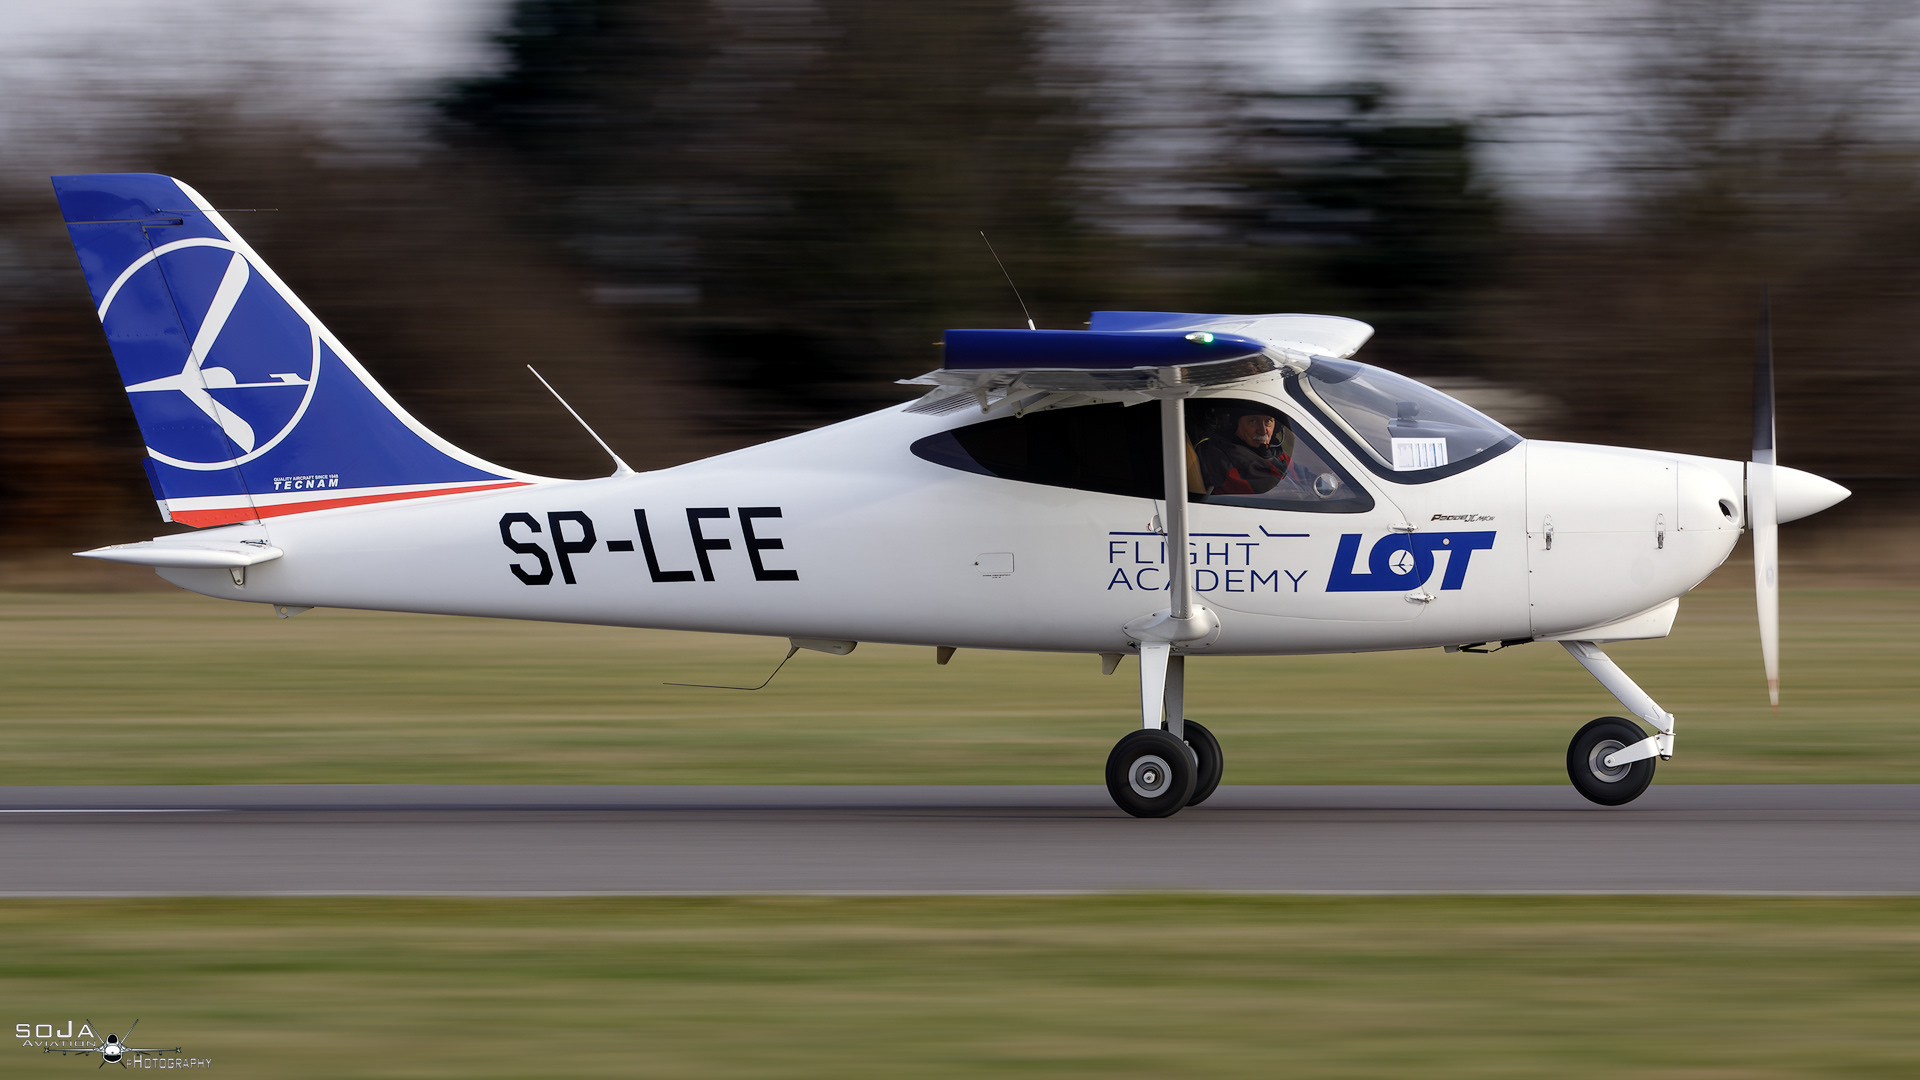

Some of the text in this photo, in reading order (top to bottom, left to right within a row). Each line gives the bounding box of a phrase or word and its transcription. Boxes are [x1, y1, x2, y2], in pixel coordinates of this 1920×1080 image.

[274, 479, 338, 490] TECNAM
[498, 506, 800, 585] SP-LFE
[1325, 531, 1497, 592] LOT
[1107, 567, 1309, 593] ACDEMY
